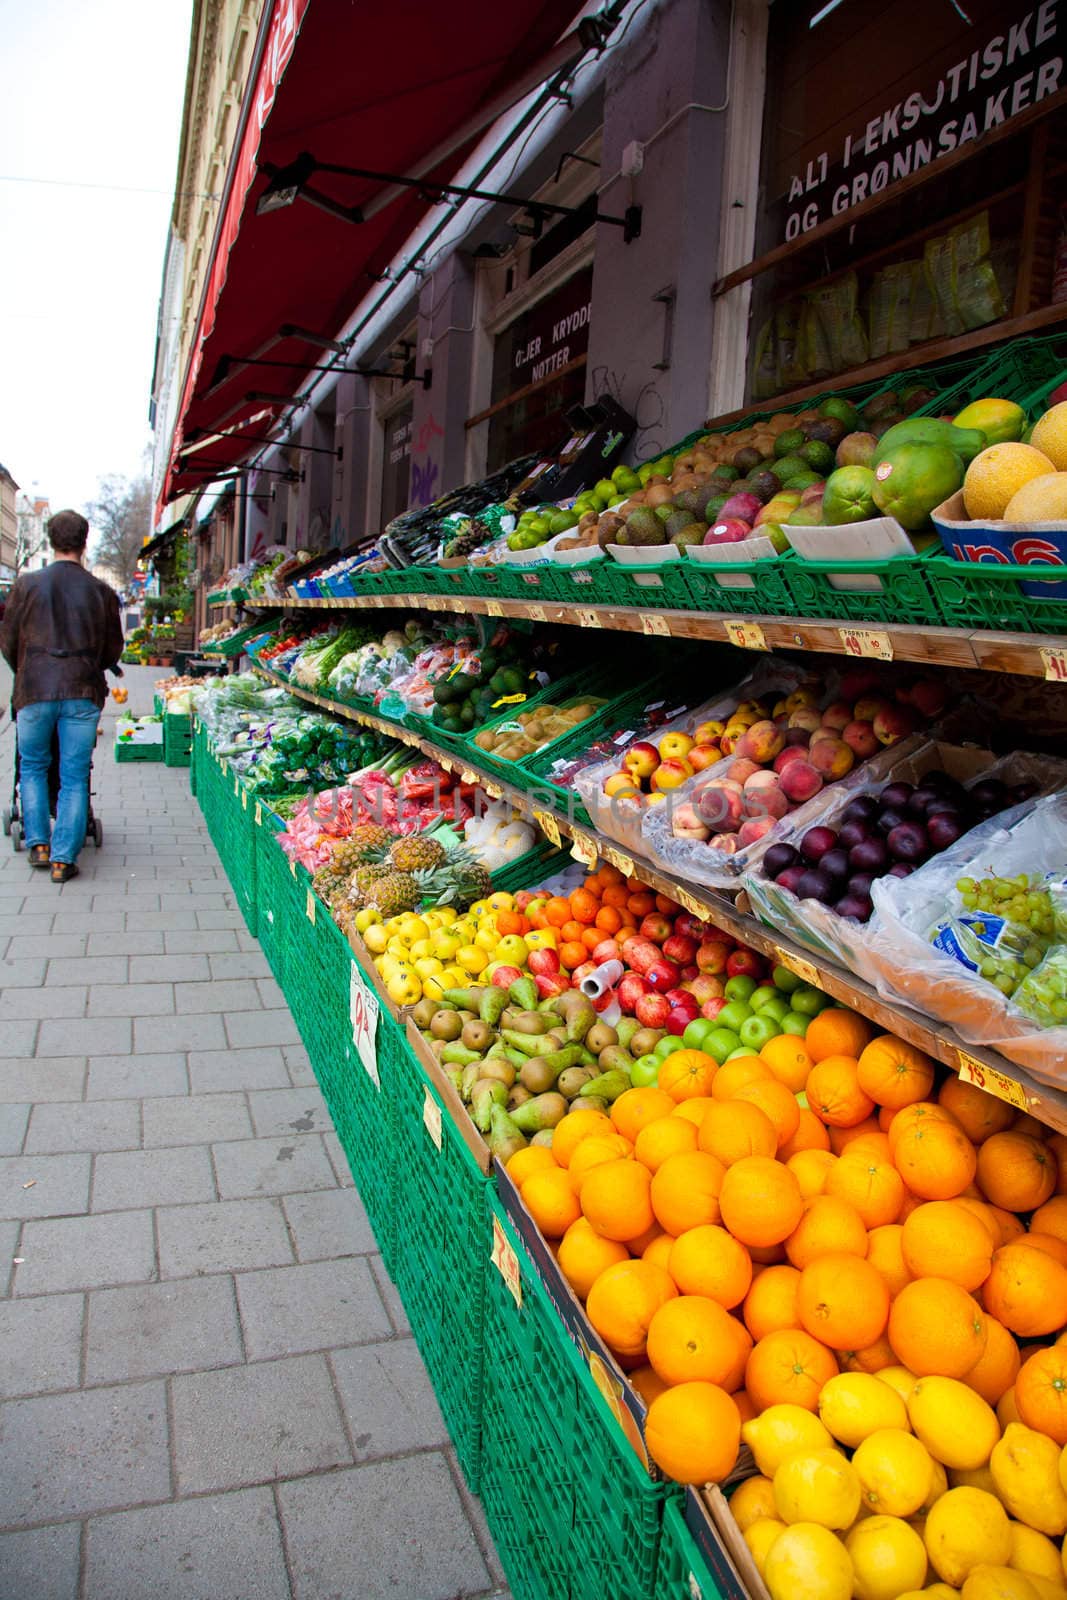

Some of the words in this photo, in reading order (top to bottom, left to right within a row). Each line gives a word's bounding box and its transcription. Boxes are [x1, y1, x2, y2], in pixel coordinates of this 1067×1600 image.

[785, 202, 818, 242] OG
[831, 57, 1063, 216] GRØNNSAKER
[788, 152, 828, 203] ALT
[843, 135, 852, 168] I
